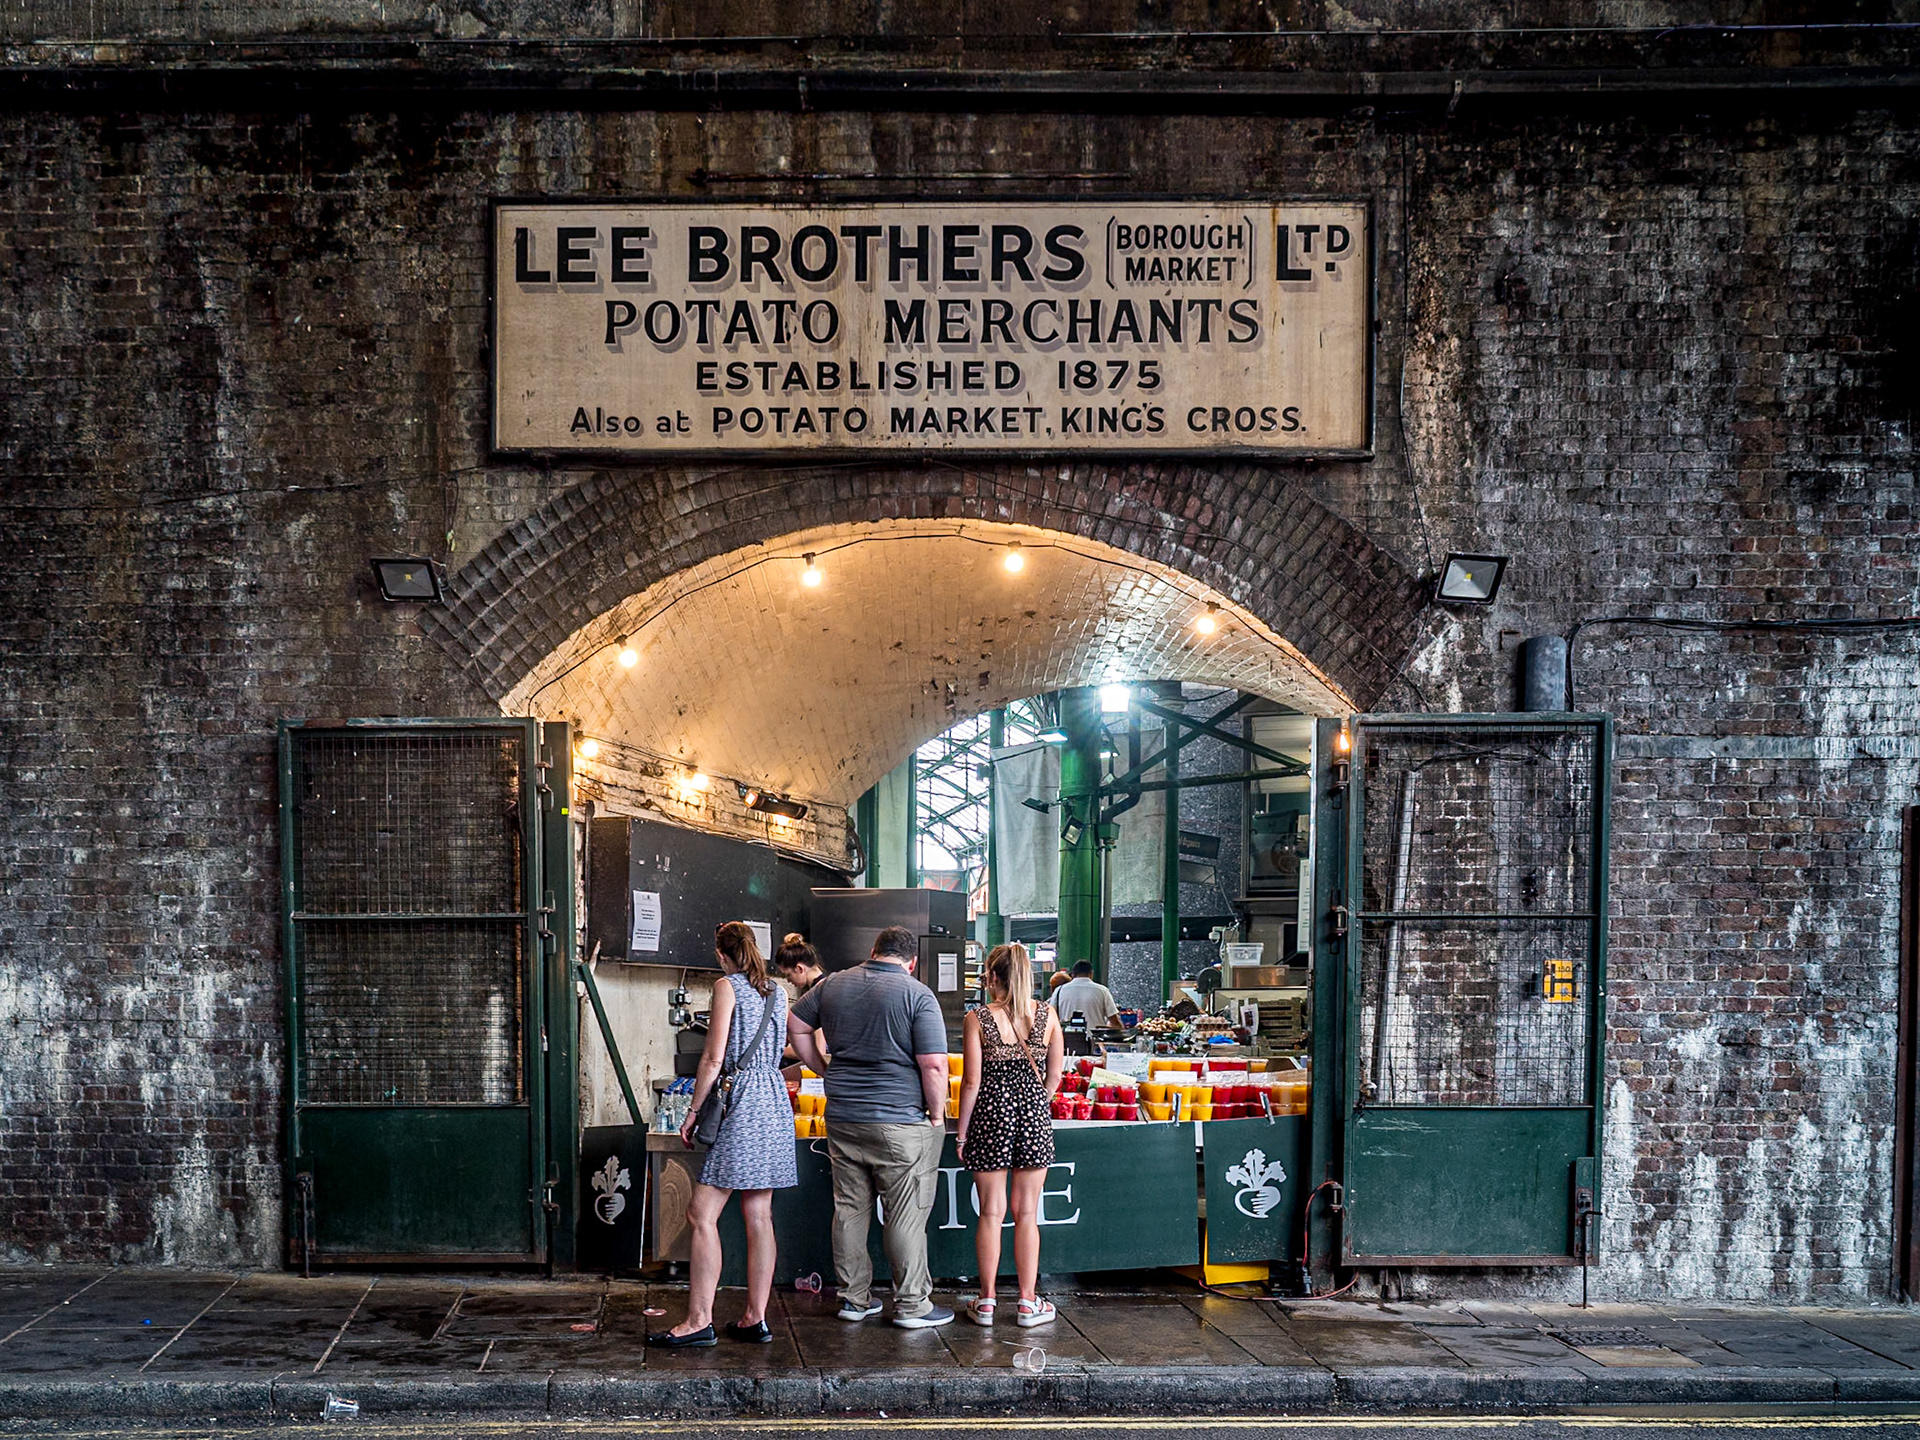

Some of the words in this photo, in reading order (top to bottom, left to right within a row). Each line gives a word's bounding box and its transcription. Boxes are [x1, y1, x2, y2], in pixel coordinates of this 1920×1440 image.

[514, 226, 650, 284] LEE
[688, 224, 1085, 285] BROTHERS
[604, 300, 839, 344] POTATO
[883, 299, 1260, 344] MERCHANTS
[696, 361, 1021, 391] ESTABLISHED
[1058, 360, 1161, 389] 1875
[570, 406, 640, 433] Also
[656, 410, 691, 433] at
[713, 407, 868, 433] POTATO
[891, 407, 1052, 437] MARKET,
[1061, 403, 1165, 433] KING'S
[1187, 406, 1307, 432] CROSS.
